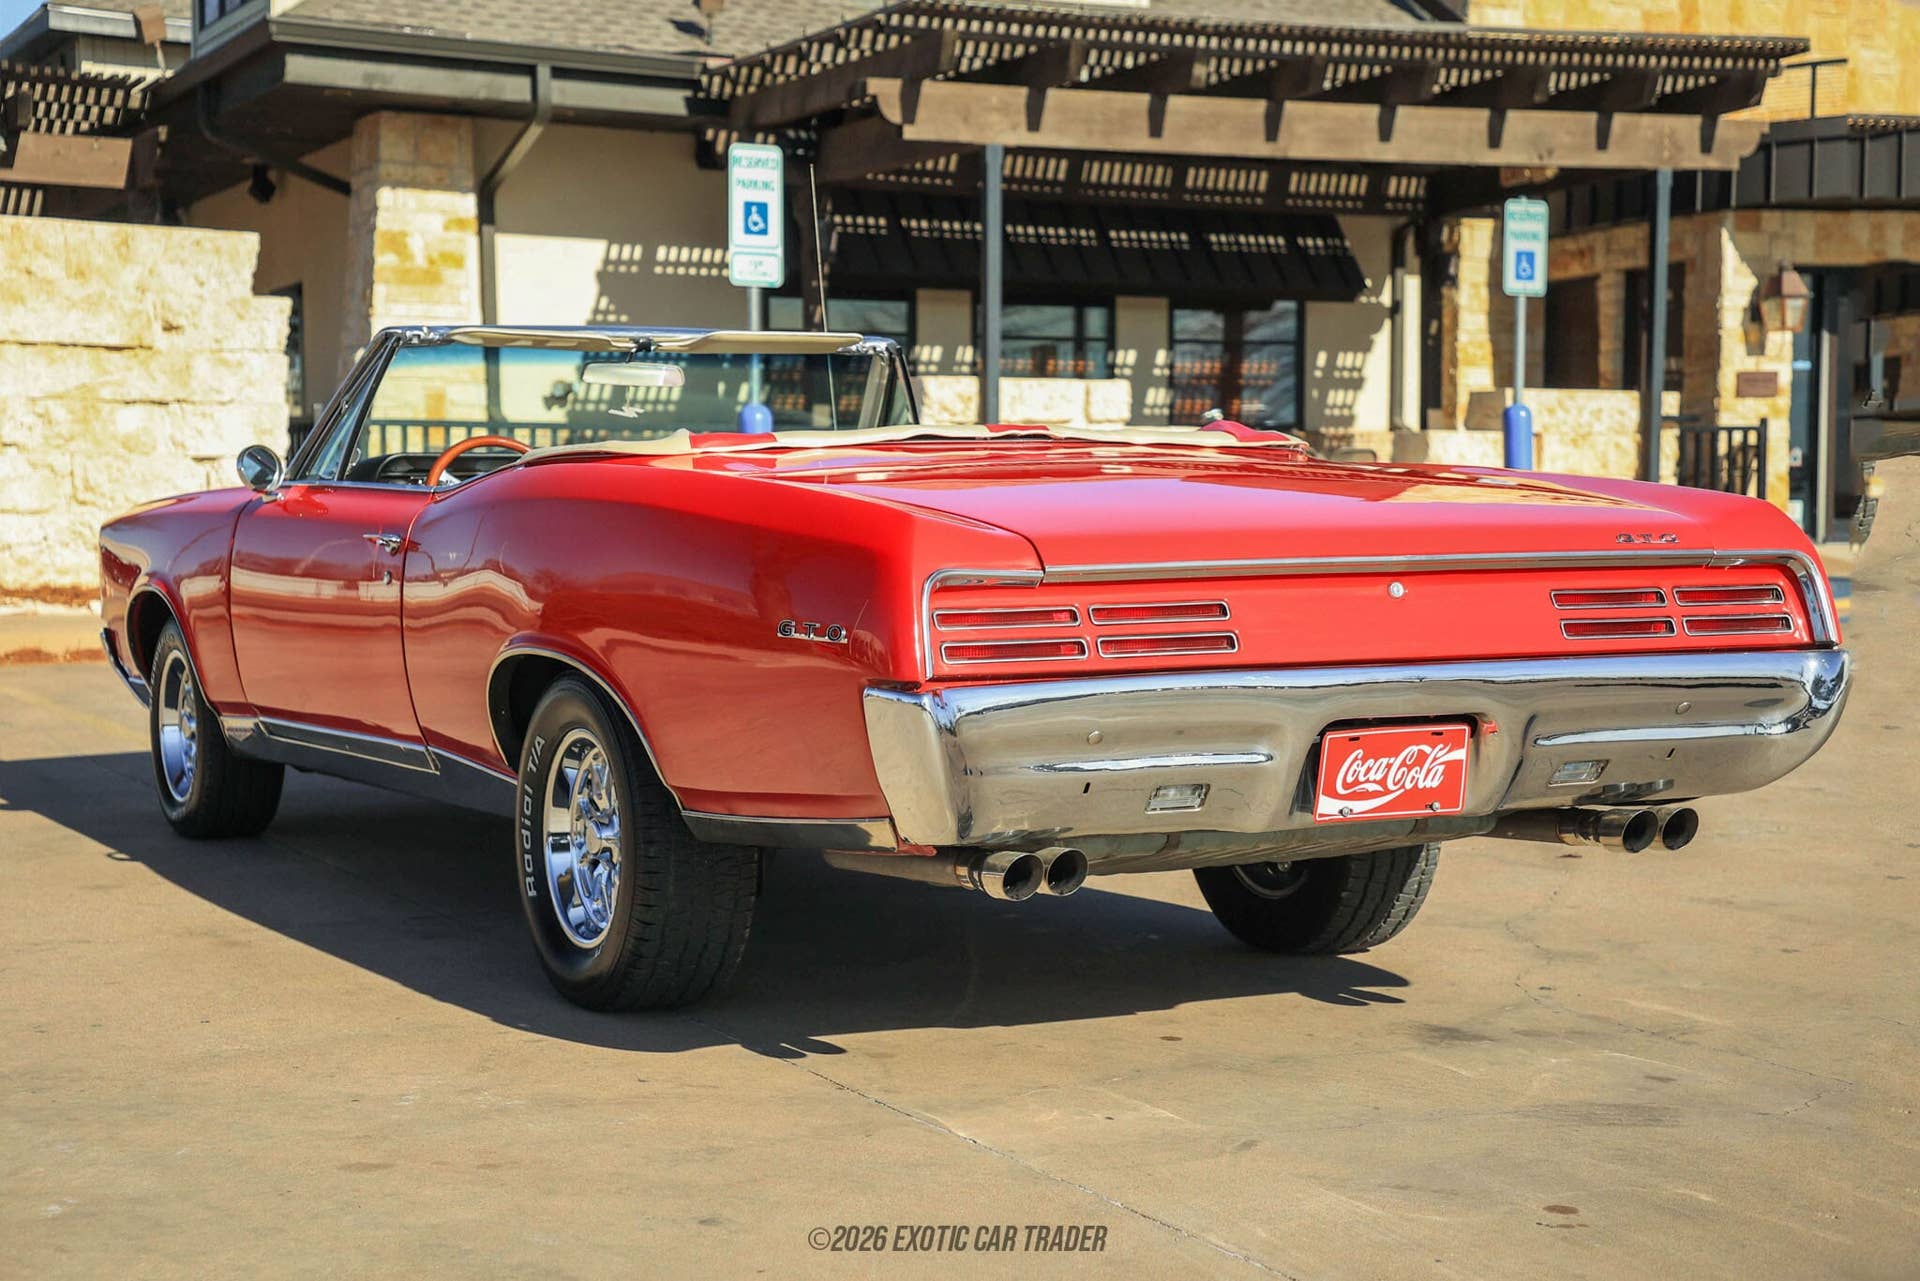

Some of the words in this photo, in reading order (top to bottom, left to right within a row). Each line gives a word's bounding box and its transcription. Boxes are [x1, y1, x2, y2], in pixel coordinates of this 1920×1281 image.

[527, 735, 546, 774] T/A
[1336, 743, 1451, 796] Coca-Cola
[521, 786, 538, 897] Radial
